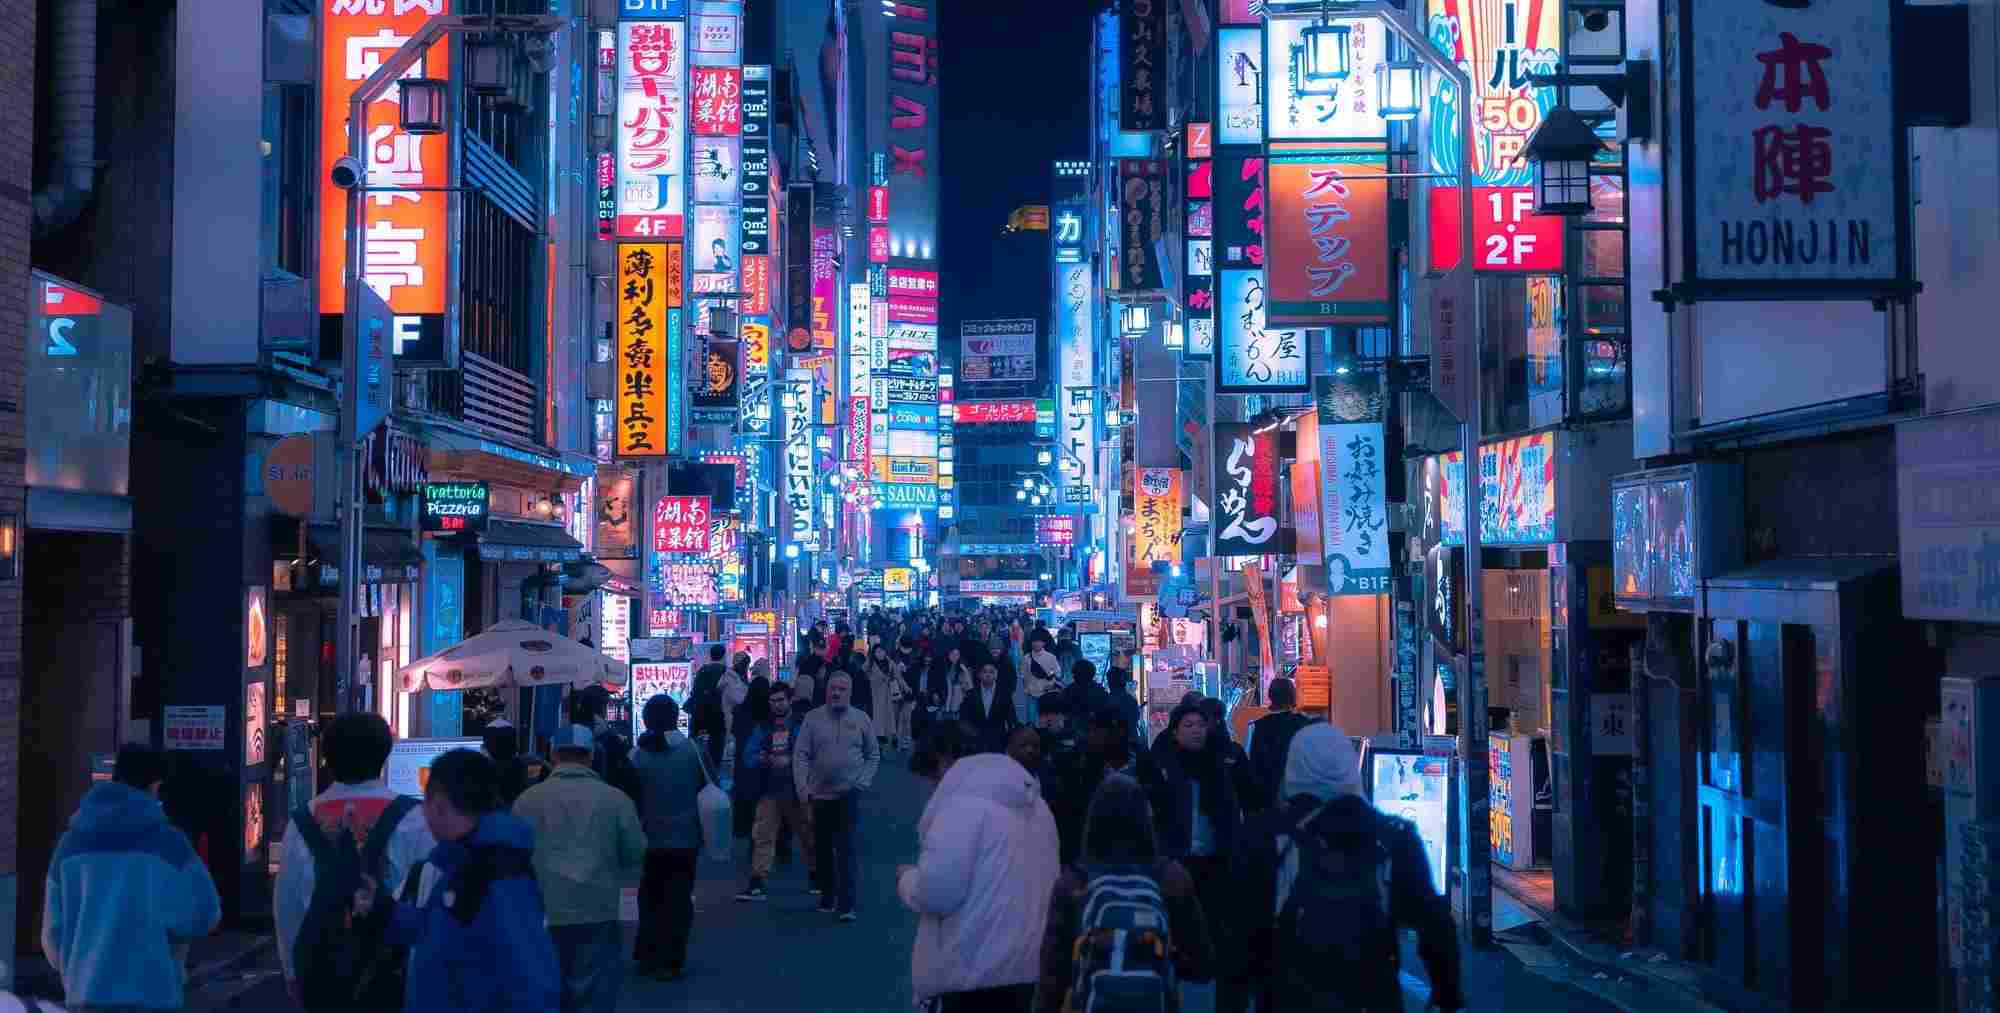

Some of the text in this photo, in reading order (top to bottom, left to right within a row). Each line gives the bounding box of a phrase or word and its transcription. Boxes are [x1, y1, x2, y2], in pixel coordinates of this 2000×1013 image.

[695, 72, 739, 98] 湖南
[1755, 31, 1834, 205] 本陣
[1488, 192, 1534, 222] 1F
[633, 217, 667, 235] 4F
[1304, 169, 1350, 297] ステップ
[1486, 235, 1536, 264] 2F
[1721, 219, 1870, 265] HONJIN
[393, 316, 421, 355] F
[1272, 332, 1300, 360] 屋
[426, 486, 484, 499] Trattoria
[888, 486, 936, 502] SAUNA
[428, 504, 480, 515] Pizzeria
[658, 500, 705, 525] 湖南
[669, 528, 704, 551] 菜館
[1359, 577, 1389, 590] B1F
